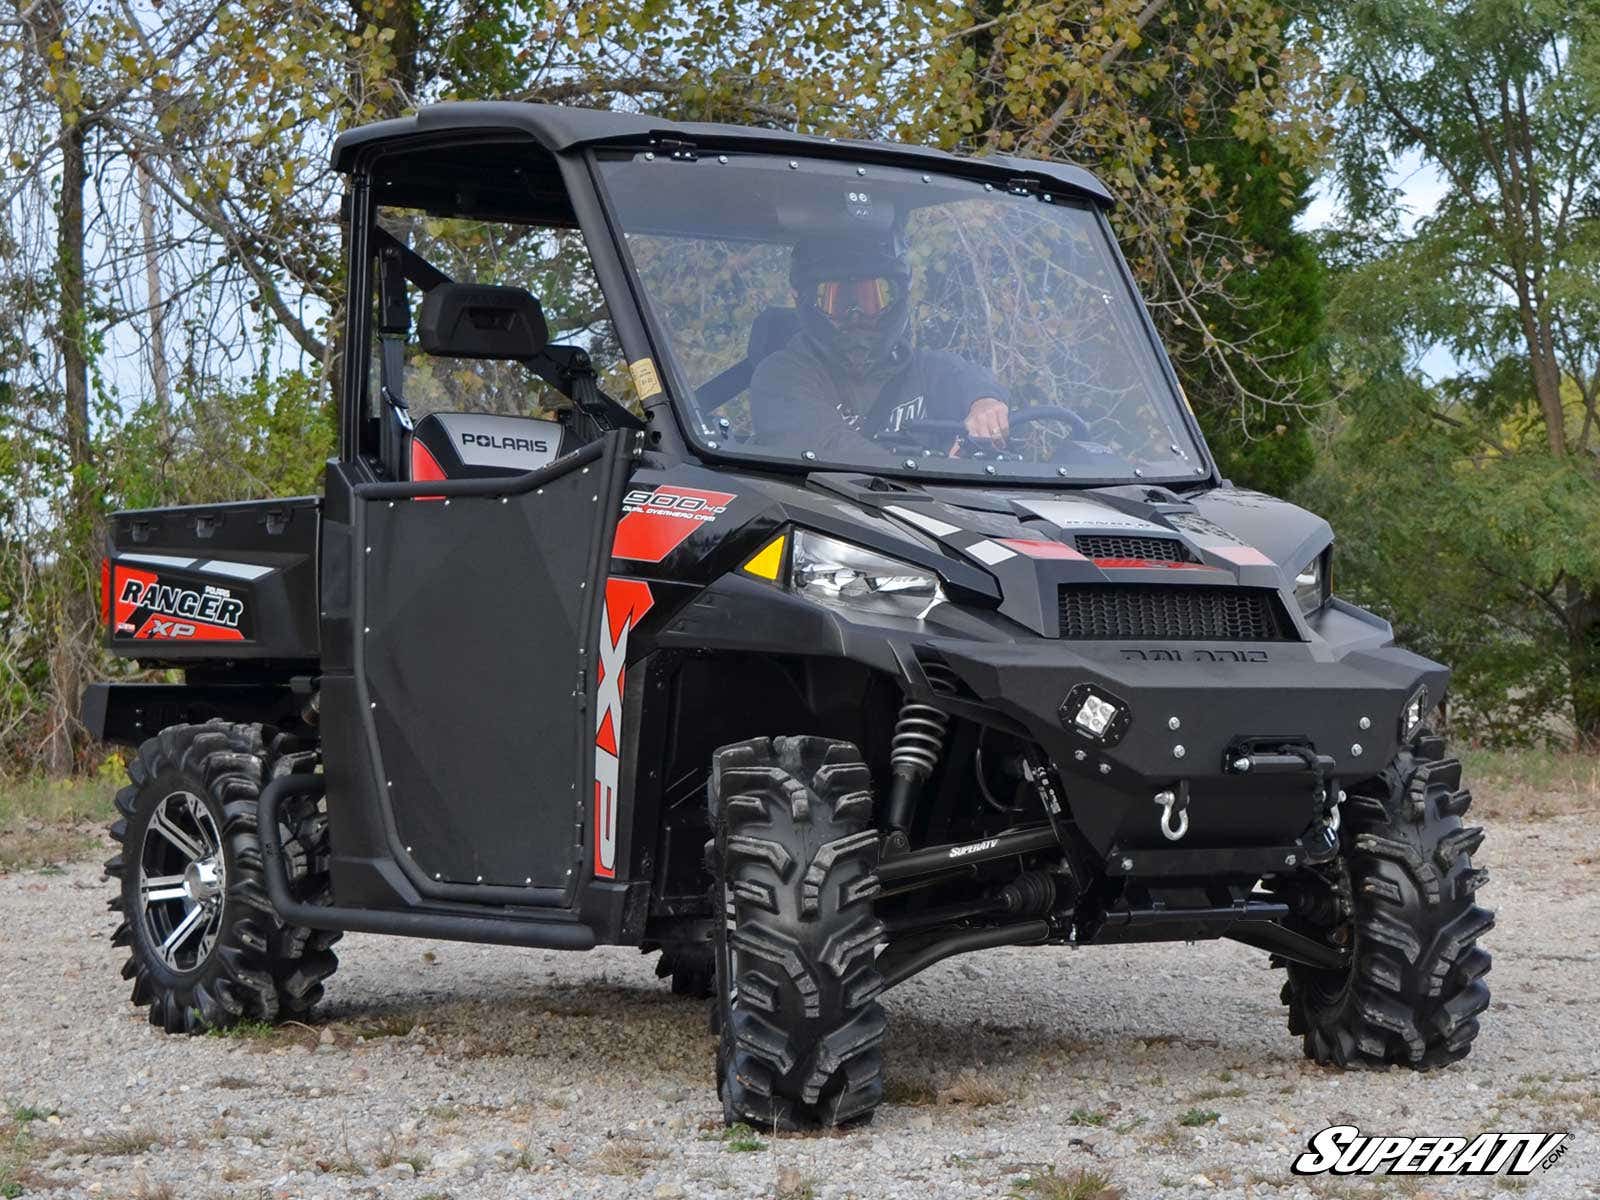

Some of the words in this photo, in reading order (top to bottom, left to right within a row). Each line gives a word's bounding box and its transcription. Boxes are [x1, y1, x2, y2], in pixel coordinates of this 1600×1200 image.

[461, 432, 548, 453] POLARIS
[622, 505, 645, 513] DUAL
[647, 508, 693, 519] OVERHEAD
[694, 514, 716, 522] CAM
[119, 578, 244, 627] RANGER
[148, 619, 197, 638] XP
[949, 839, 1000, 858] SUPERATV
